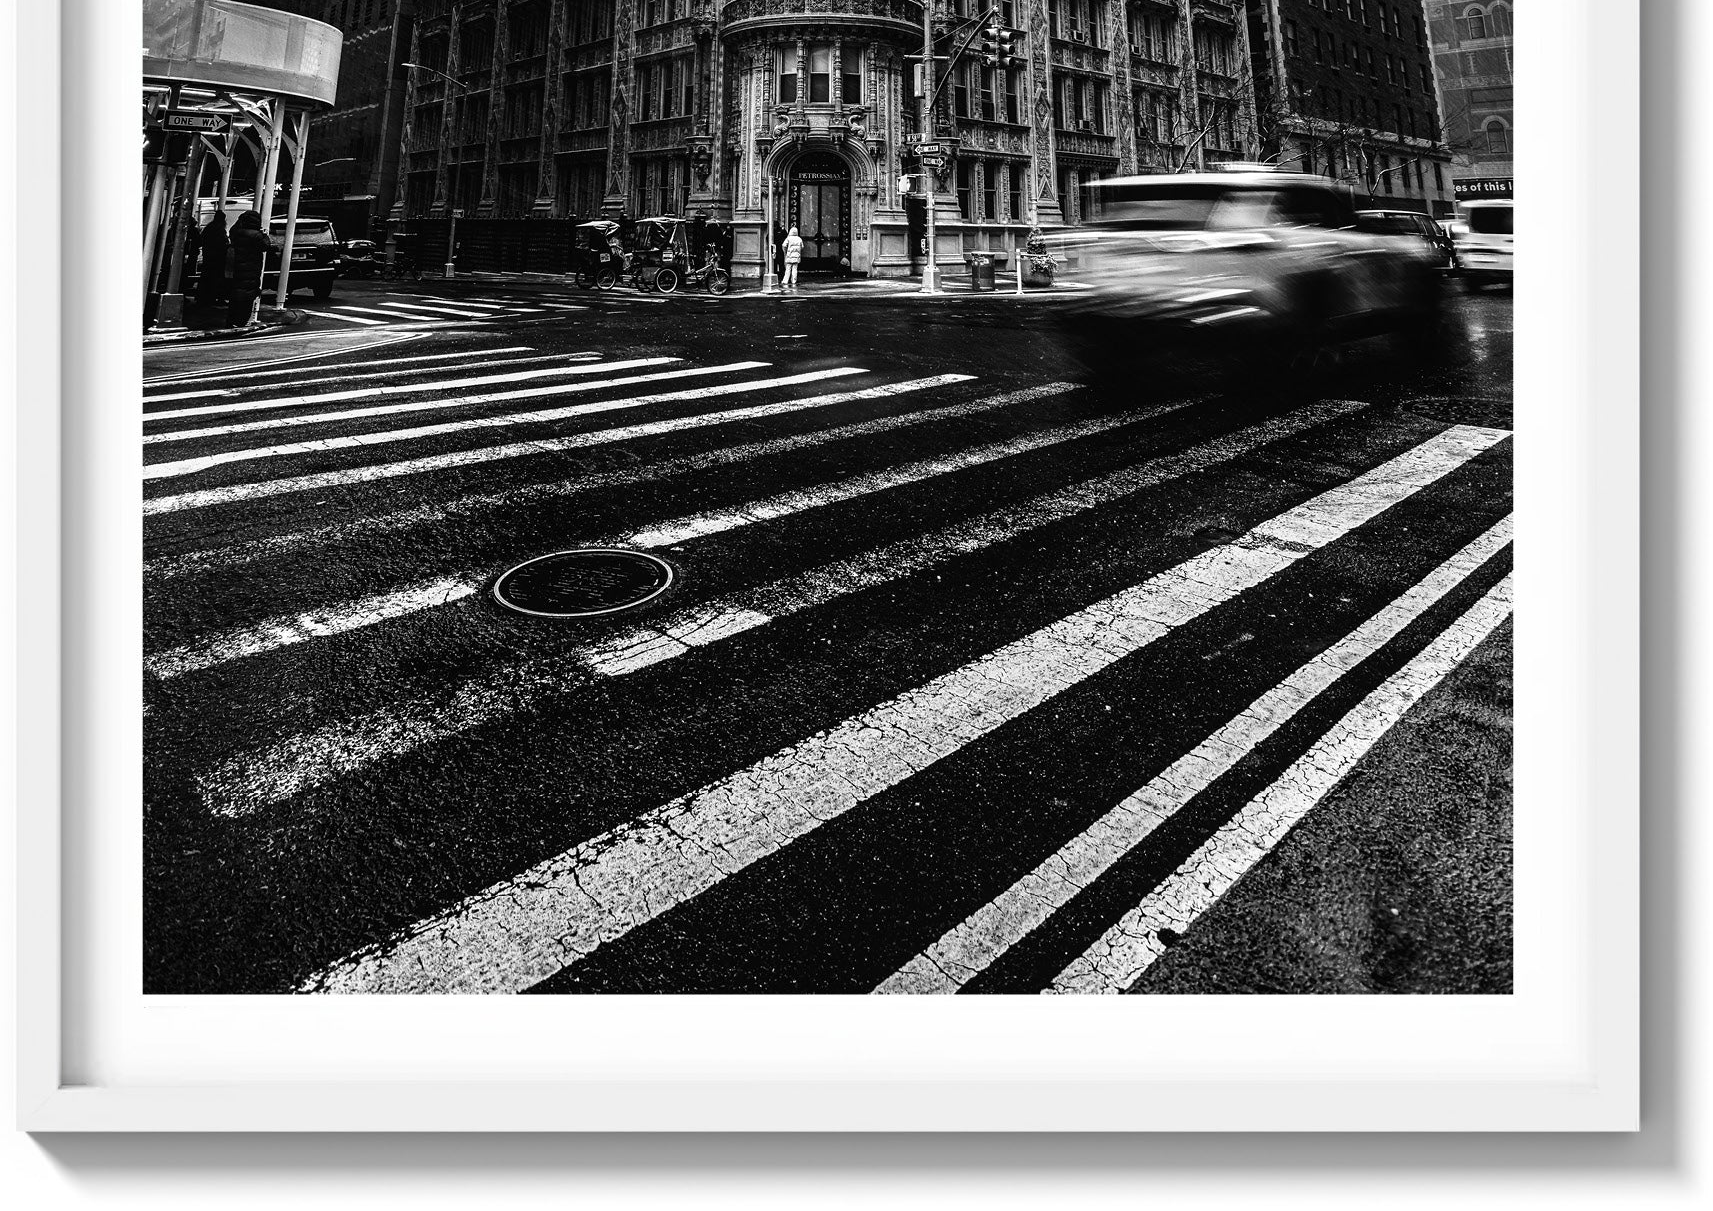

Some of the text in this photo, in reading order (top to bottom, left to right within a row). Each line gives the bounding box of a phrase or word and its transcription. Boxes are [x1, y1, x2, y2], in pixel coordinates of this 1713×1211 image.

[174, 116, 221, 127] ONE WAY
[1470, 182, 1481, 191] of
[1484, 181, 1506, 191] this
